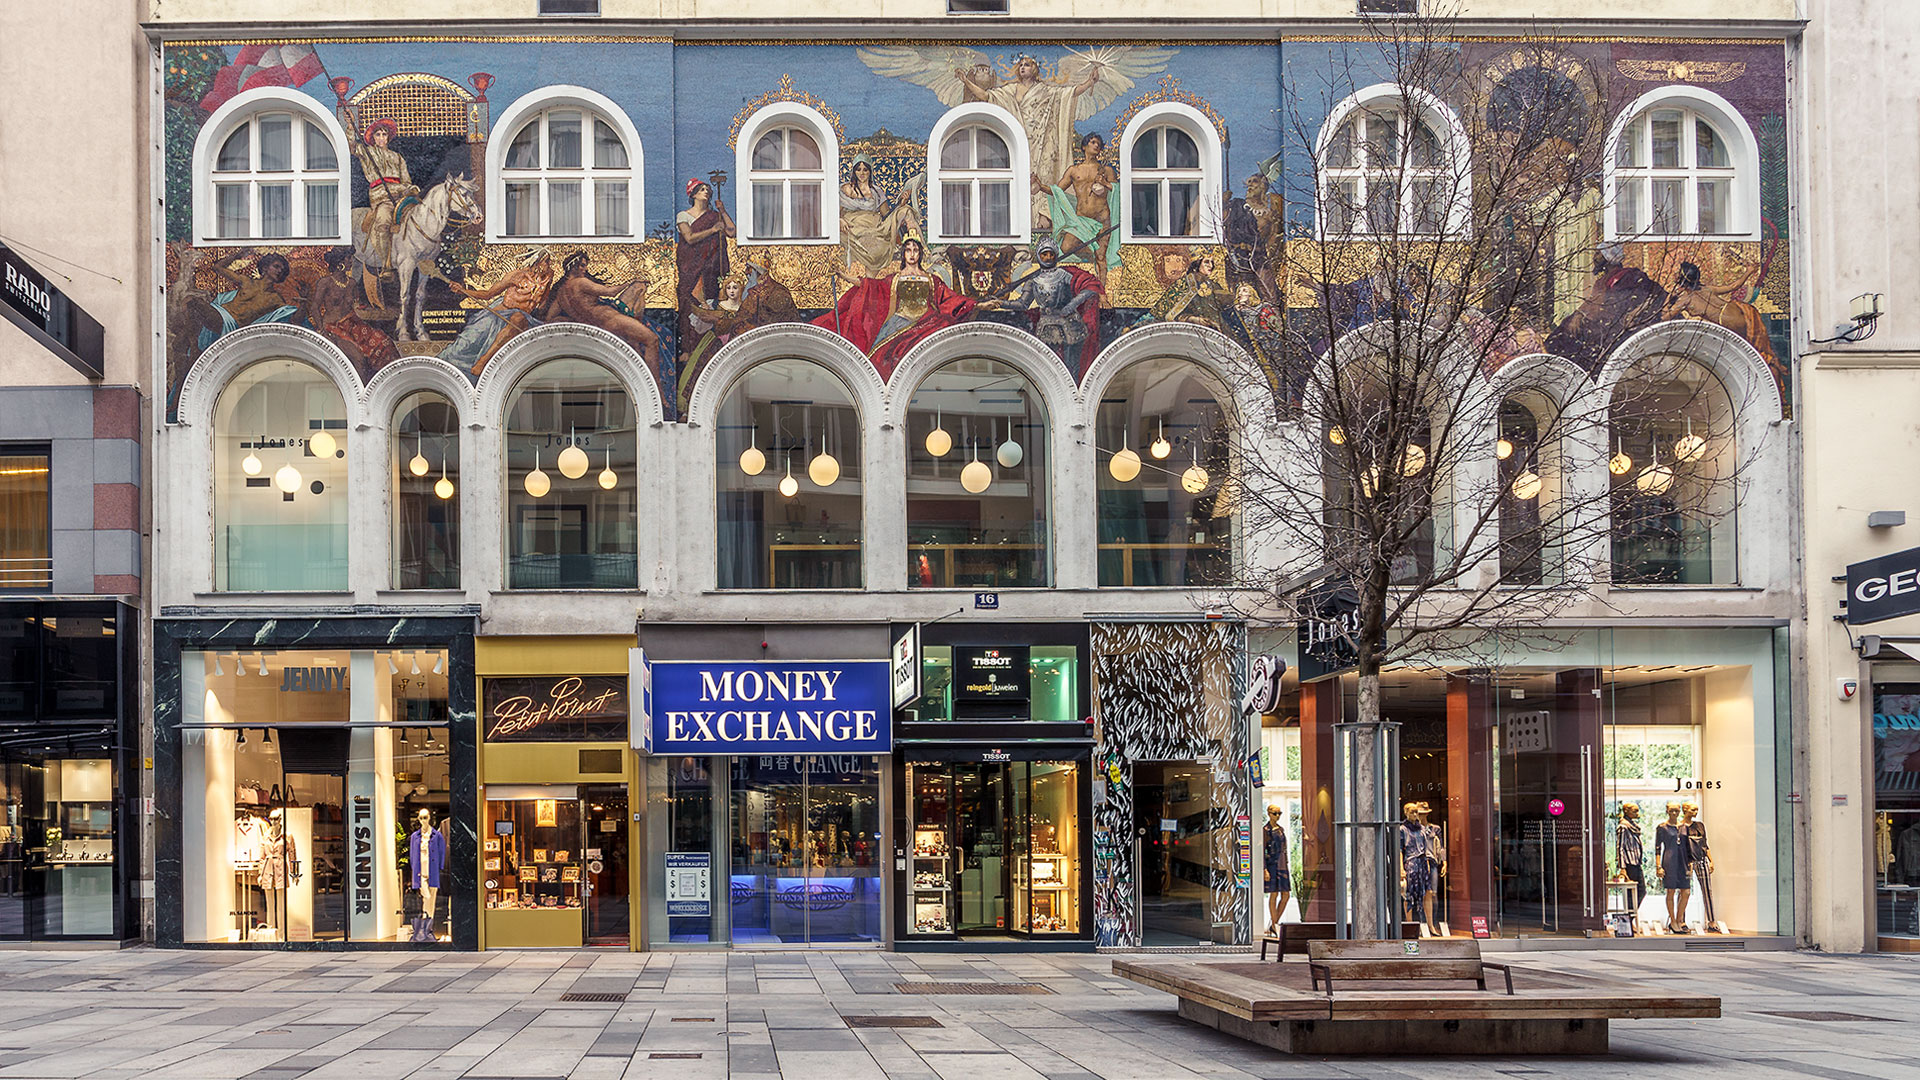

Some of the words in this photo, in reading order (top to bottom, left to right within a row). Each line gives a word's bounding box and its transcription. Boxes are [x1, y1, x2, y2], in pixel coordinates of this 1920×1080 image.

[5, 282, 50, 321] SWITZERLAND
[6, 262, 50, 311] RADO
[258, 435, 303, 450] Jones
[545, 432, 590, 448] Jones
[979, 594, 995, 604] 16
[1854, 568, 1920, 602] GE
[1305, 604, 1359, 654] Jones
[896, 656, 913, 688] TISSOT
[972, 657, 1012, 665] TISSOT
[280, 666, 347, 691] JENNY
[699, 671, 842, 701] MONEY
[487, 696, 548, 739] Petit
[547, 677, 618, 721] Point
[665, 710, 878, 742] EXCHANGE
[793, 755, 860, 774] CHANGE
[1673, 777, 1721, 792] Jones
[353, 795, 371, 824] JIL
[354, 826, 372, 915] SANDER
